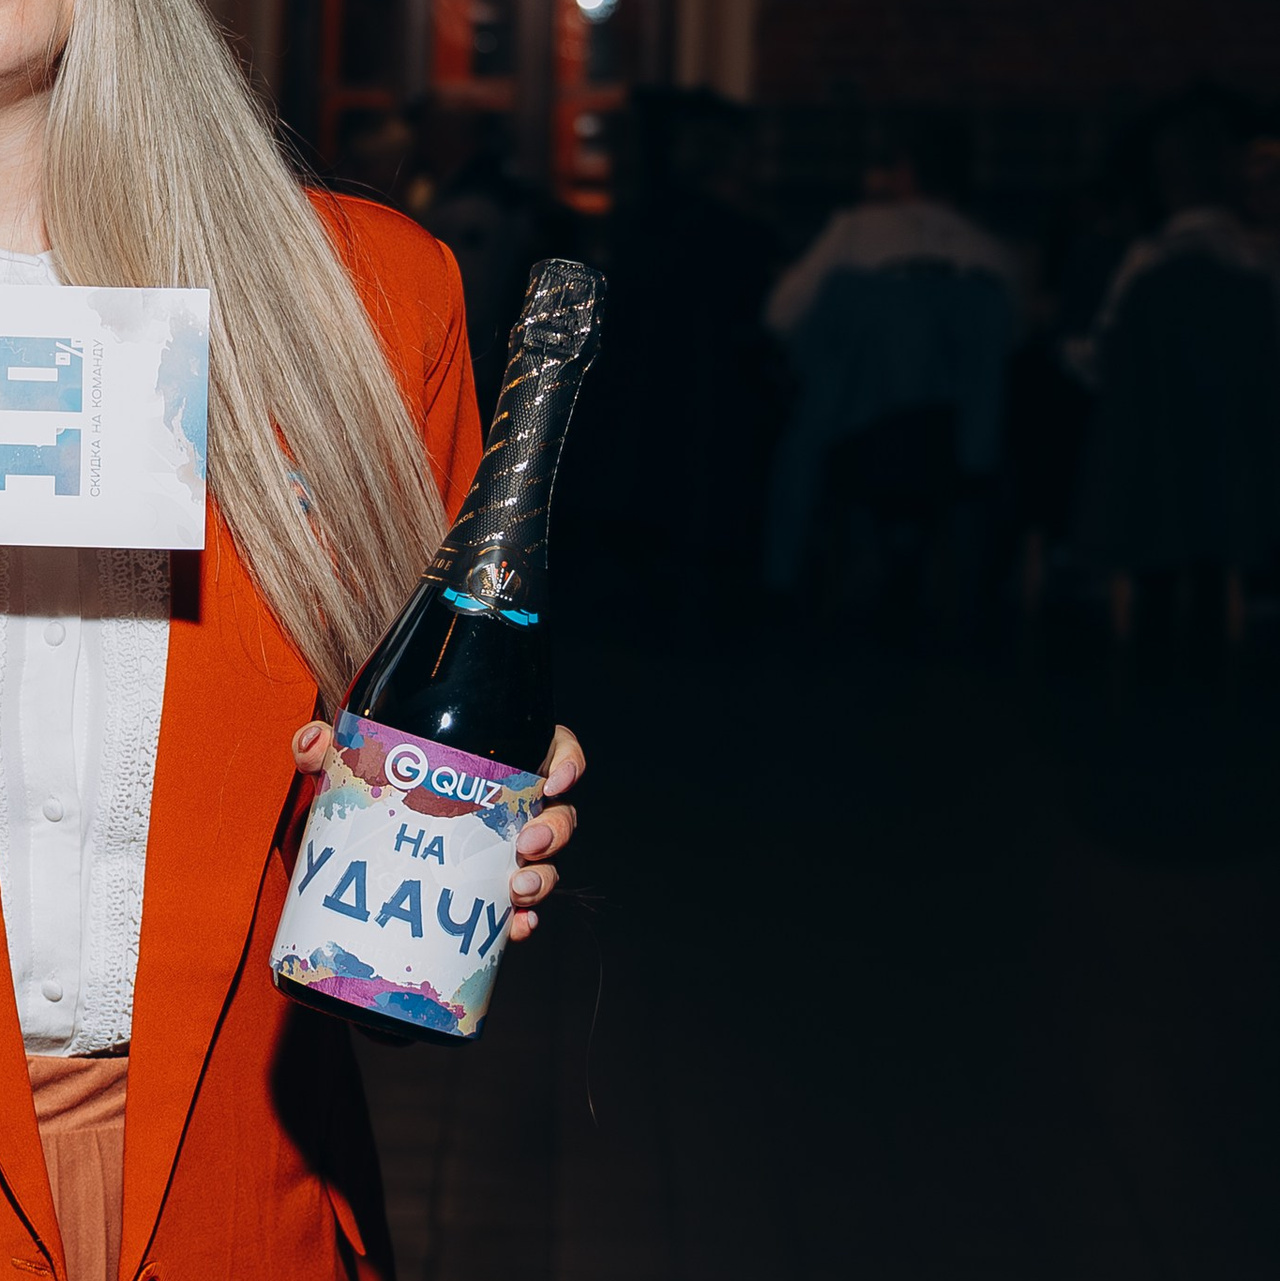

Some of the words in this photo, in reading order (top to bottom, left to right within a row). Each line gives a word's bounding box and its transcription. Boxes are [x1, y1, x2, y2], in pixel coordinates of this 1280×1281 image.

[92, 338, 105, 408] КОМАНДУ
[91, 415, 102, 433] НА
[89, 439, 102, 498] СКИДКА
[431, 766, 503, 809] QUIZ
[393, 823, 445, 865] НА
[297, 839, 513, 958] УДАЧУ
